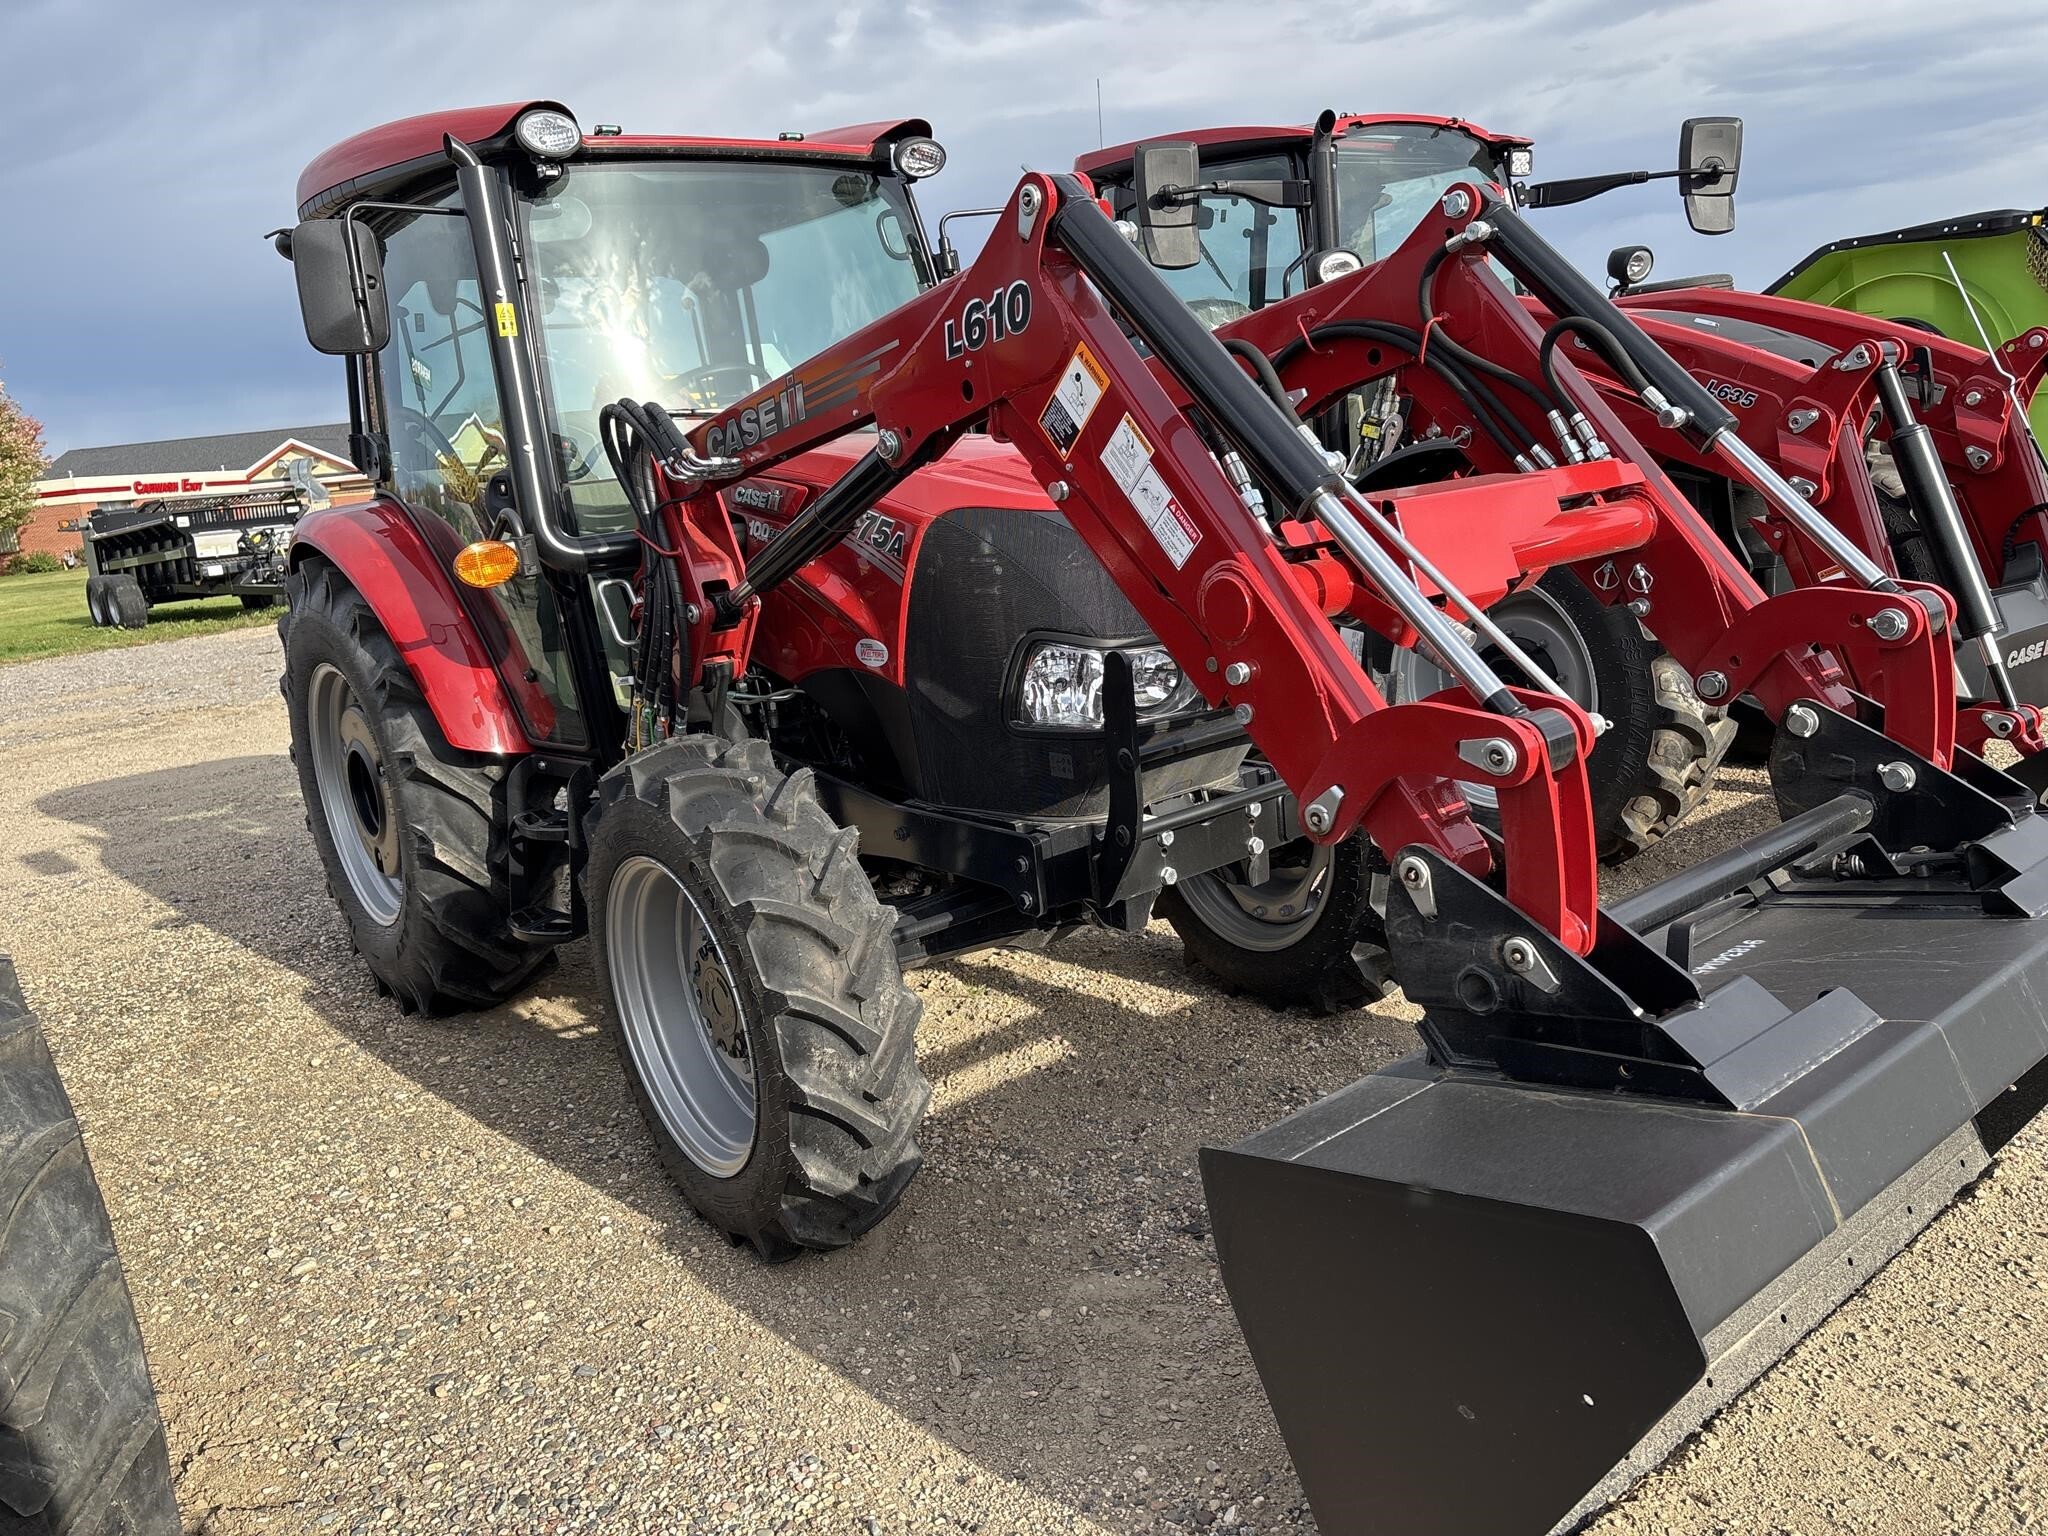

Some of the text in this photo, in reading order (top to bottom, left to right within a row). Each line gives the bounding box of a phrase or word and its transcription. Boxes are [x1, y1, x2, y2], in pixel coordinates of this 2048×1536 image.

[944, 279, 1033, 361] L610
[1083, 357, 1105, 386] WARNING
[1705, 379, 1759, 409] L635
[707, 398, 778, 458] CASE
[735, 486, 769, 508] CASE
[856, 510, 905, 559] 75A
[1175, 510, 1198, 541] DANGER
[2006, 640, 2045, 669] CASE
